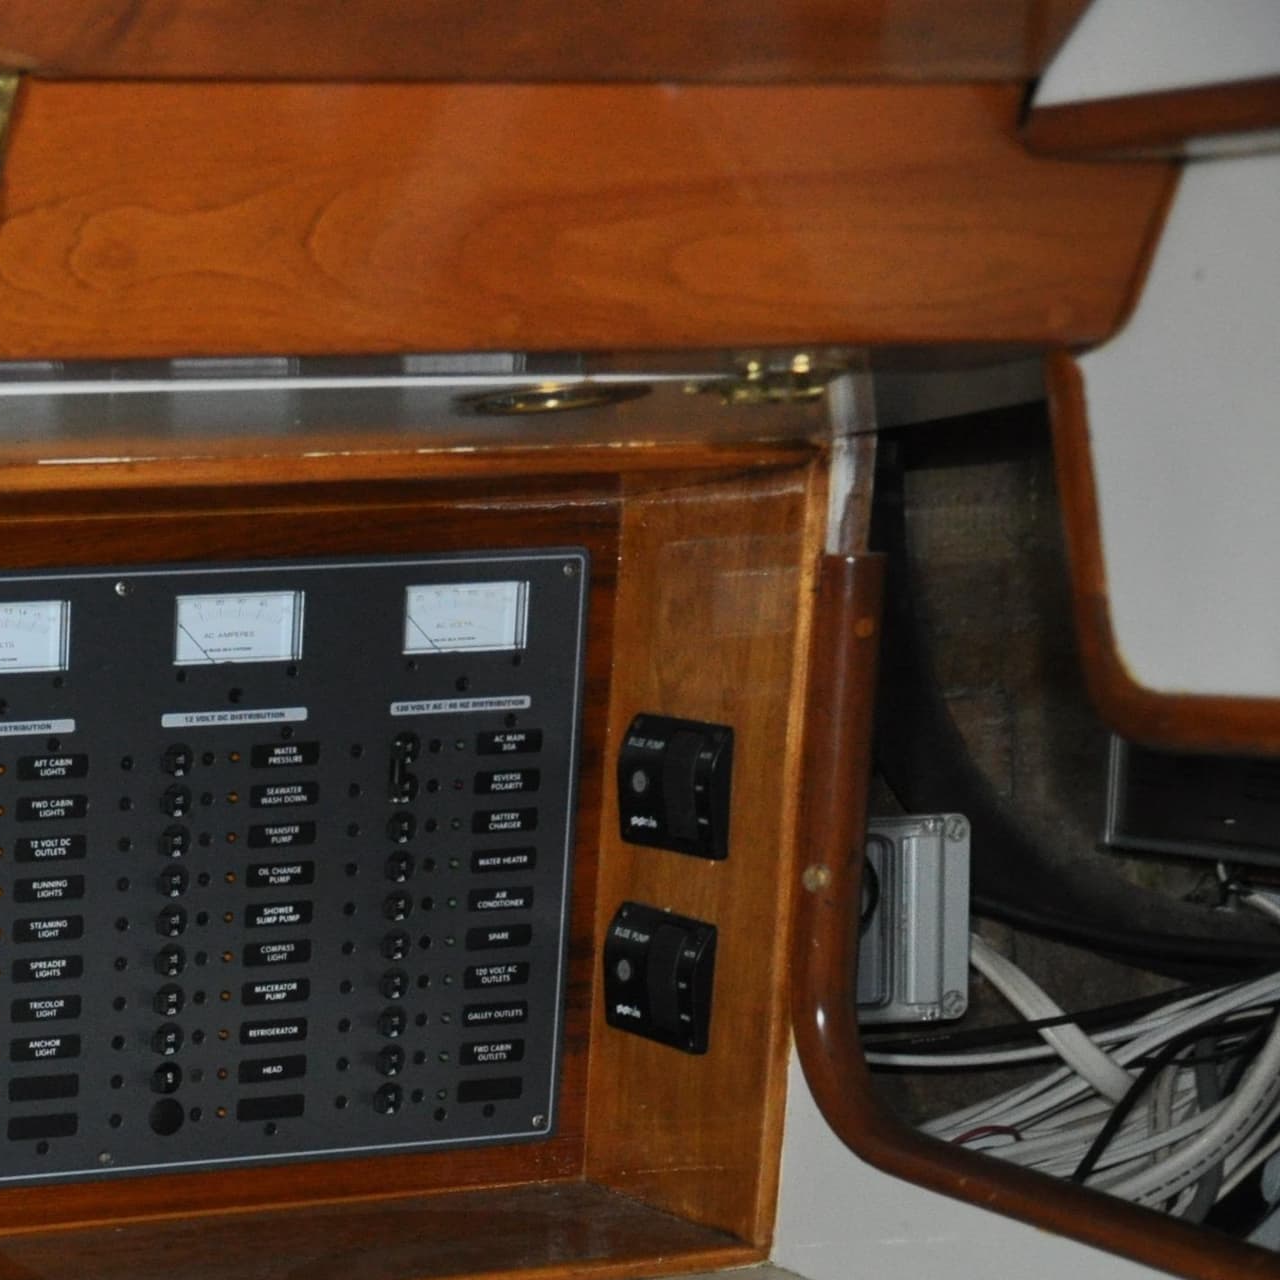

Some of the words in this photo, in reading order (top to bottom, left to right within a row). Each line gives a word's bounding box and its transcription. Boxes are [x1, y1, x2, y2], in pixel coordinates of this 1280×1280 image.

[410, 704, 431, 712] VOLT
[472, 698, 526, 708] DISTRIBUTION
[218, 714, 229, 722] DC
[230, 712, 286, 721] DISTRIBUTION
[506, 734, 526, 742] MAIN
[274, 746, 298, 755] WATER
[49, 758, 73, 766] CABIN
[268, 755, 303, 765] PRESSURE
[40, 768, 66, 776] LIGHTS
[493, 773, 522, 782] REVERSE
[491, 782, 523, 790] POLARITY
[266, 786, 302, 796] SEAWATER
[260, 796, 282, 804] WASH
[284, 794, 308, 803] DOWN
[32, 801, 48, 809] FWD
[50, 800, 74, 808] CABIN
[40, 808, 66, 818] LIGHTS
[490, 813, 520, 822] BATTERY
[488, 821, 522, 830] CHARGER
[264, 826, 300, 835] TRANSFER
[30, 840, 39, 848] 12
[40, 840, 58, 848] VOLT
[60, 838, 72, 846] DC
[270, 835, 293, 844] PUMP
[34, 848, 67, 857] OUTLETS
[478, 858, 500, 866] WATER
[502, 856, 528, 864] HEATER
[272, 866, 302, 875] CHANGE
[268, 875, 290, 884] PUMP
[32, 880, 68, 890] RUNNING
[37, 890, 63, 898] LIGHTS
[495, 891, 508, 899] AIR
[477, 898, 524, 910] CONDITIONER
[263, 906, 294, 916] SHOWER
[256, 916, 277, 925] SUMP
[278, 914, 300, 923] PUMP
[30, 920, 68, 930] STEAMING
[38, 930, 59, 938] LIGHT
[488, 932, 509, 941] SPARE
[260, 944, 295, 954] COMPASS
[266, 952, 288, 962] LIGHT
[30, 960, 67, 970] SPREADER
[35, 969, 61, 978] LIGHTS
[490, 966, 506, 975] VOLT
[481, 974, 510, 984] OUTLETS
[254, 982, 298, 993] MACERATOR
[265, 992, 288, 1000] PUMP
[29, 1000, 65, 1009] TRICOLOR
[36, 1009, 57, 1018] LIGHT
[467, 1011, 492, 1020] GALLEY
[494, 1008, 523, 1018] OUTLETS
[248, 1026, 298, 1038] REFRIGERATOR
[29, 1039, 61, 1048] ANCHOR
[35, 1048, 56, 1057] LIGHT
[474, 1046, 489, 1054] FWD
[490, 1044, 512, 1052] CABIN
[478, 1052, 507, 1062] OUTLETS
[262, 1065, 283, 1074] HEAD
